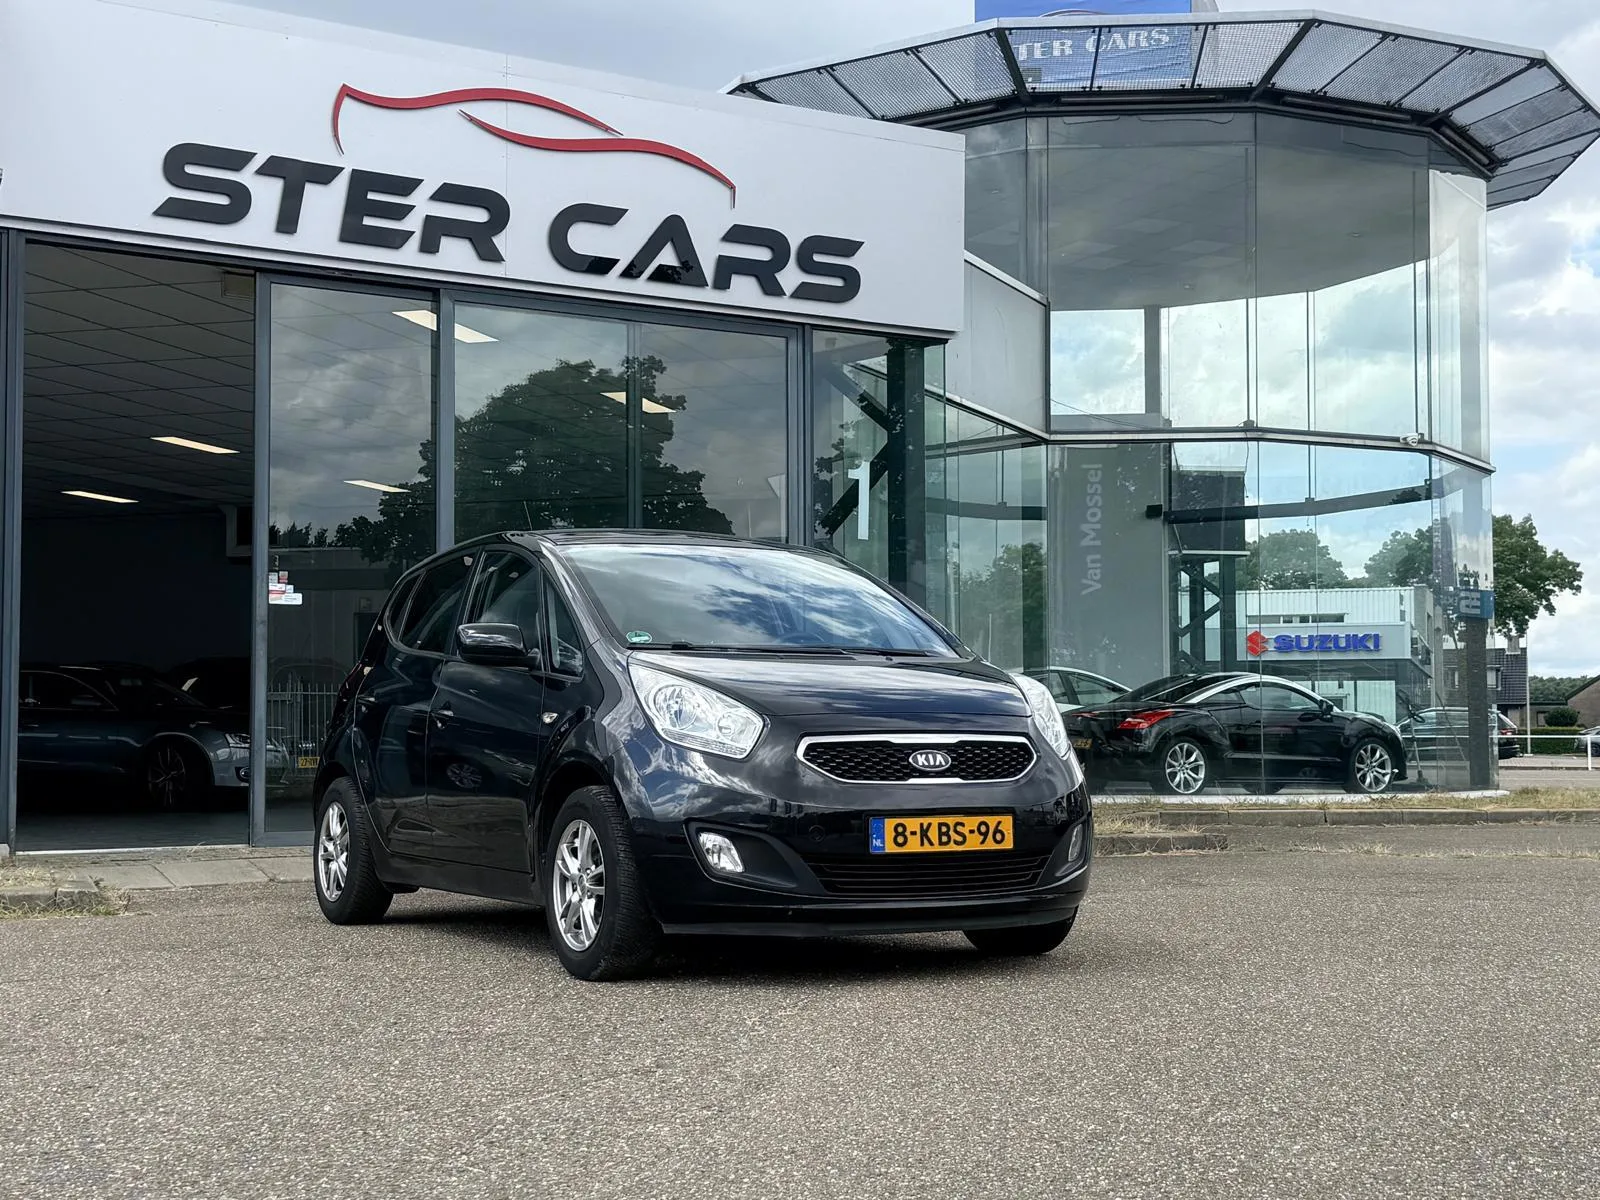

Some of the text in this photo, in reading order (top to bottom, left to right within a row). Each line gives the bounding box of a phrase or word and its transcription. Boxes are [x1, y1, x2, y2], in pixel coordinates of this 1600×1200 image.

[1012, 28, 1170, 61] TER CARS
[152, 142, 866, 304] STER CARS
[1080, 463, 1103, 596] Van Mossel
[1273, 633, 1381, 653] SUZUKI
[916, 753, 946, 766] KIA
[872, 820, 1006, 848] NL 8-KBS-96
